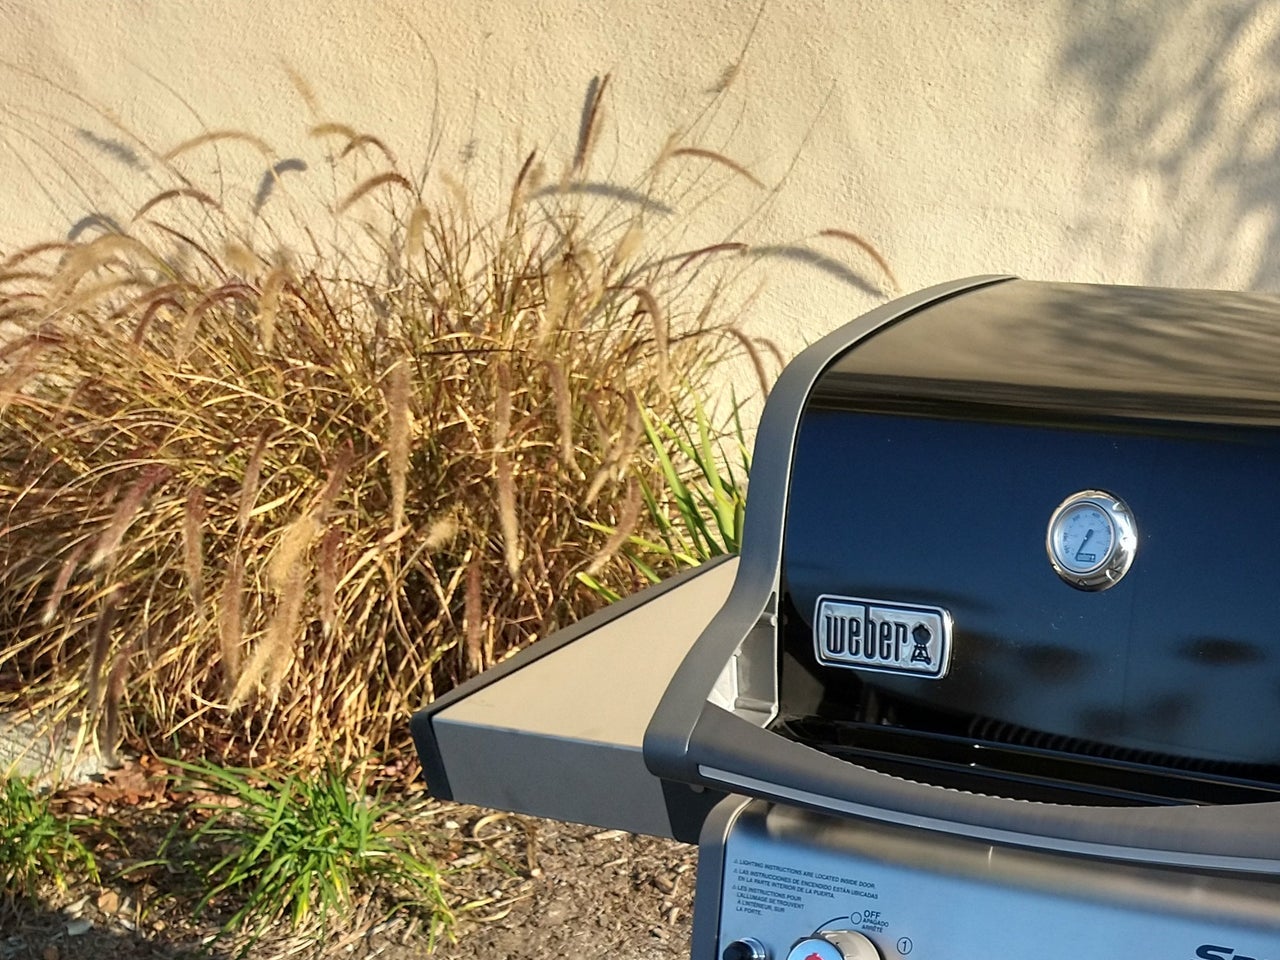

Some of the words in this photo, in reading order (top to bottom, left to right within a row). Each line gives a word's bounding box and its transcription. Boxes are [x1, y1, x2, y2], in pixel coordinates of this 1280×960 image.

[825, 606, 910, 662] weber
[739, 859, 763, 867] LIGHTING
[764, 864, 801, 874] INSTRUCTIONS
[815, 873, 839, 882] LOCATED
[754, 878, 769, 886] PARTE
[771, 882, 796, 890] INTERIOR
[801, 880, 831, 890] ENCENDIDO
[851, 890, 878, 899] UBICADAS
[748, 887, 785, 898] INSTRUCTIONS
[777, 899, 804, 909] TROUVENT
[864, 910, 880, 918] OFF
[863, 917, 889, 927] APAGADO
